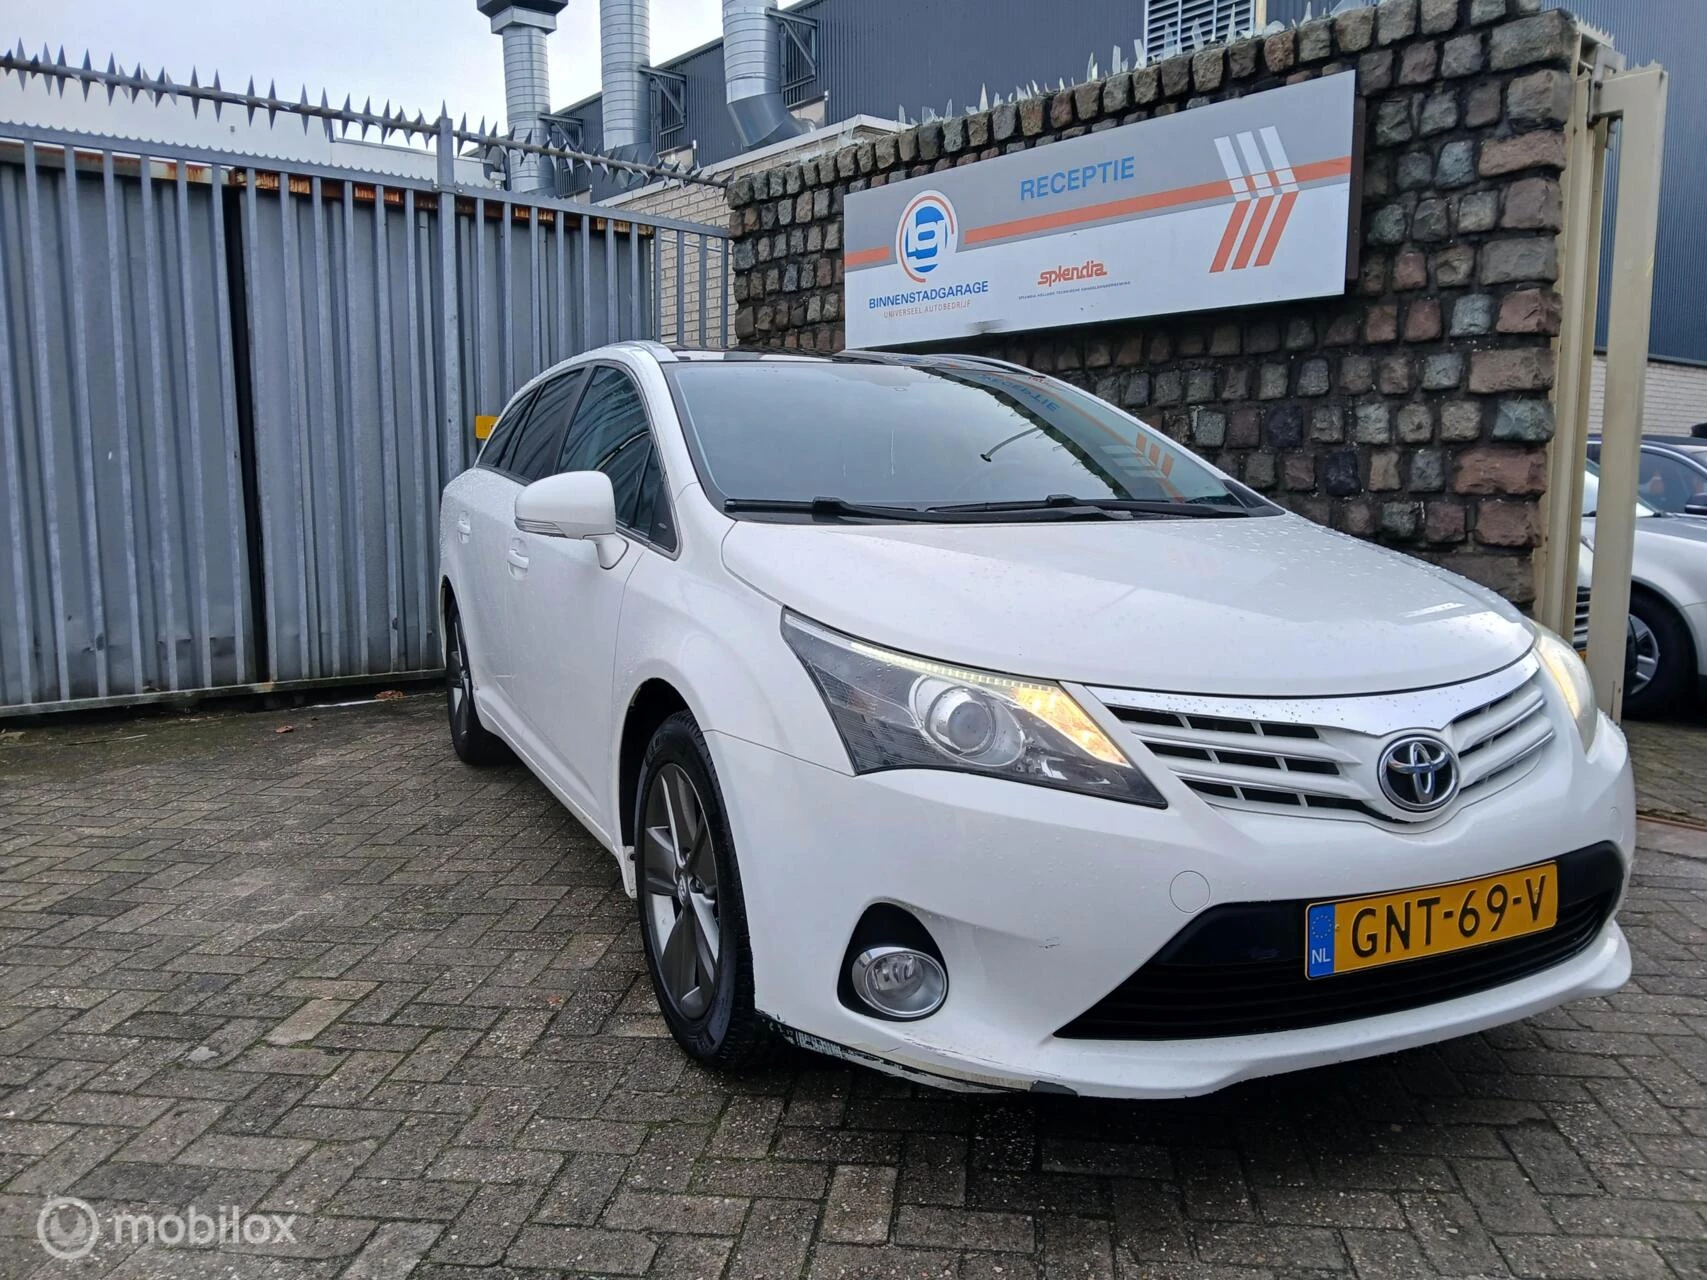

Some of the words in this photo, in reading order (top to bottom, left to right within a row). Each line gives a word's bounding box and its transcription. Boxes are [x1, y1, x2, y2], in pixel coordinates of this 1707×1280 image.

[1020, 156, 1135, 200] RECEPTIE
[1038, 260, 1107, 287] splendia
[868, 280, 989, 309] BINNENSTADGARAGE
[883, 306, 922, 319] UNIVERSEEL
[924, 299, 971, 313] AUTOBEDRIJF
[1351, 875, 1547, 958] GNT-69-V
[1311, 947, 1331, 965] NL
